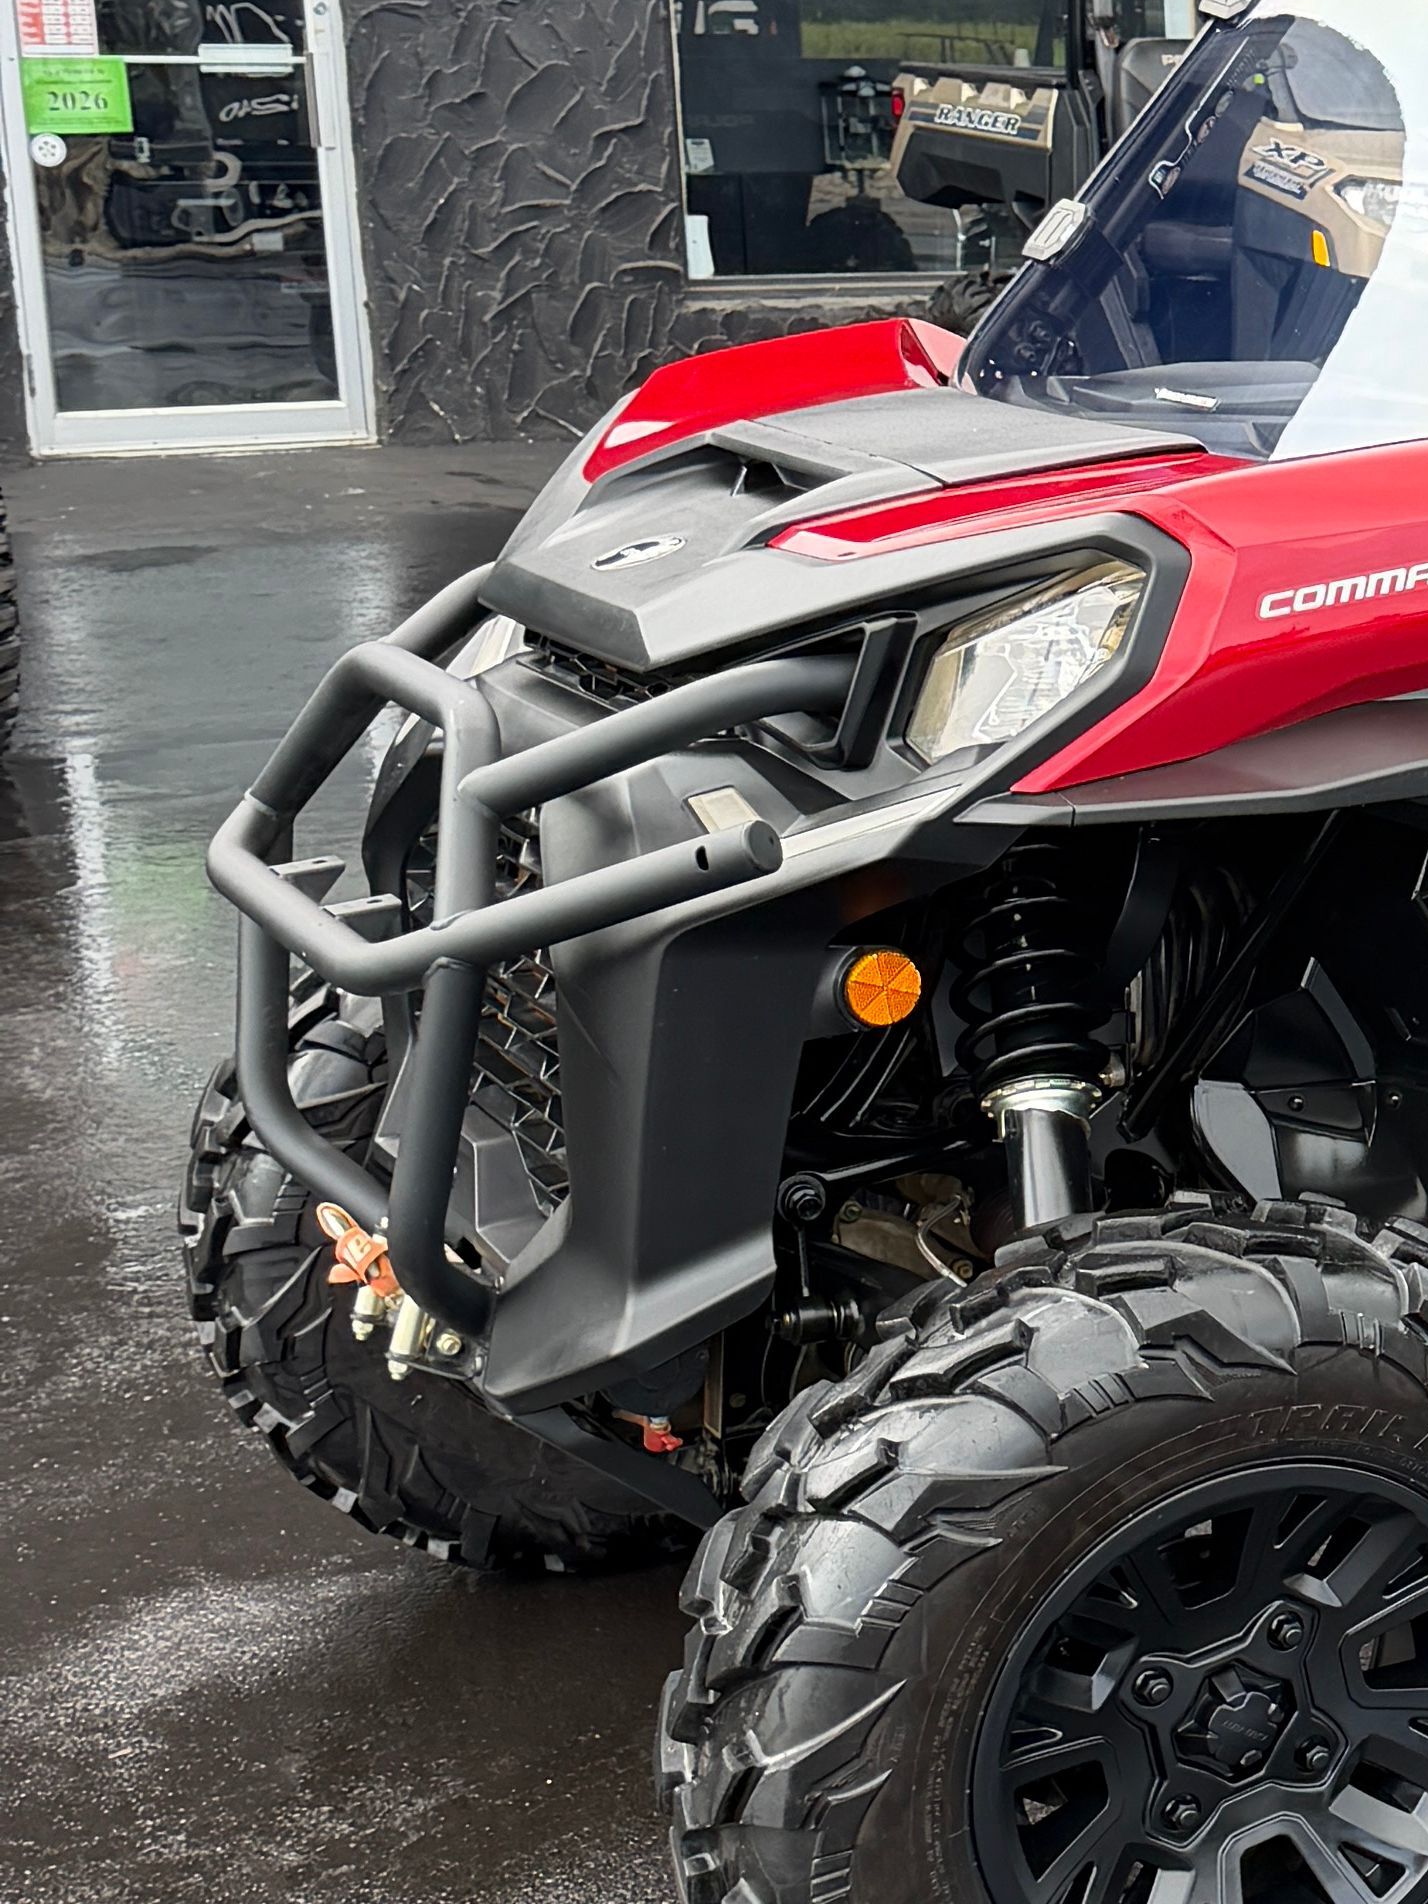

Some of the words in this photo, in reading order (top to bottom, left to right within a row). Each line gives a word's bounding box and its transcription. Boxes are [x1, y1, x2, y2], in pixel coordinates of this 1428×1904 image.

[46, 91, 108, 111] 2026
[935, 105, 1021, 134] RANGER
[1258, 138, 1326, 168] XP
